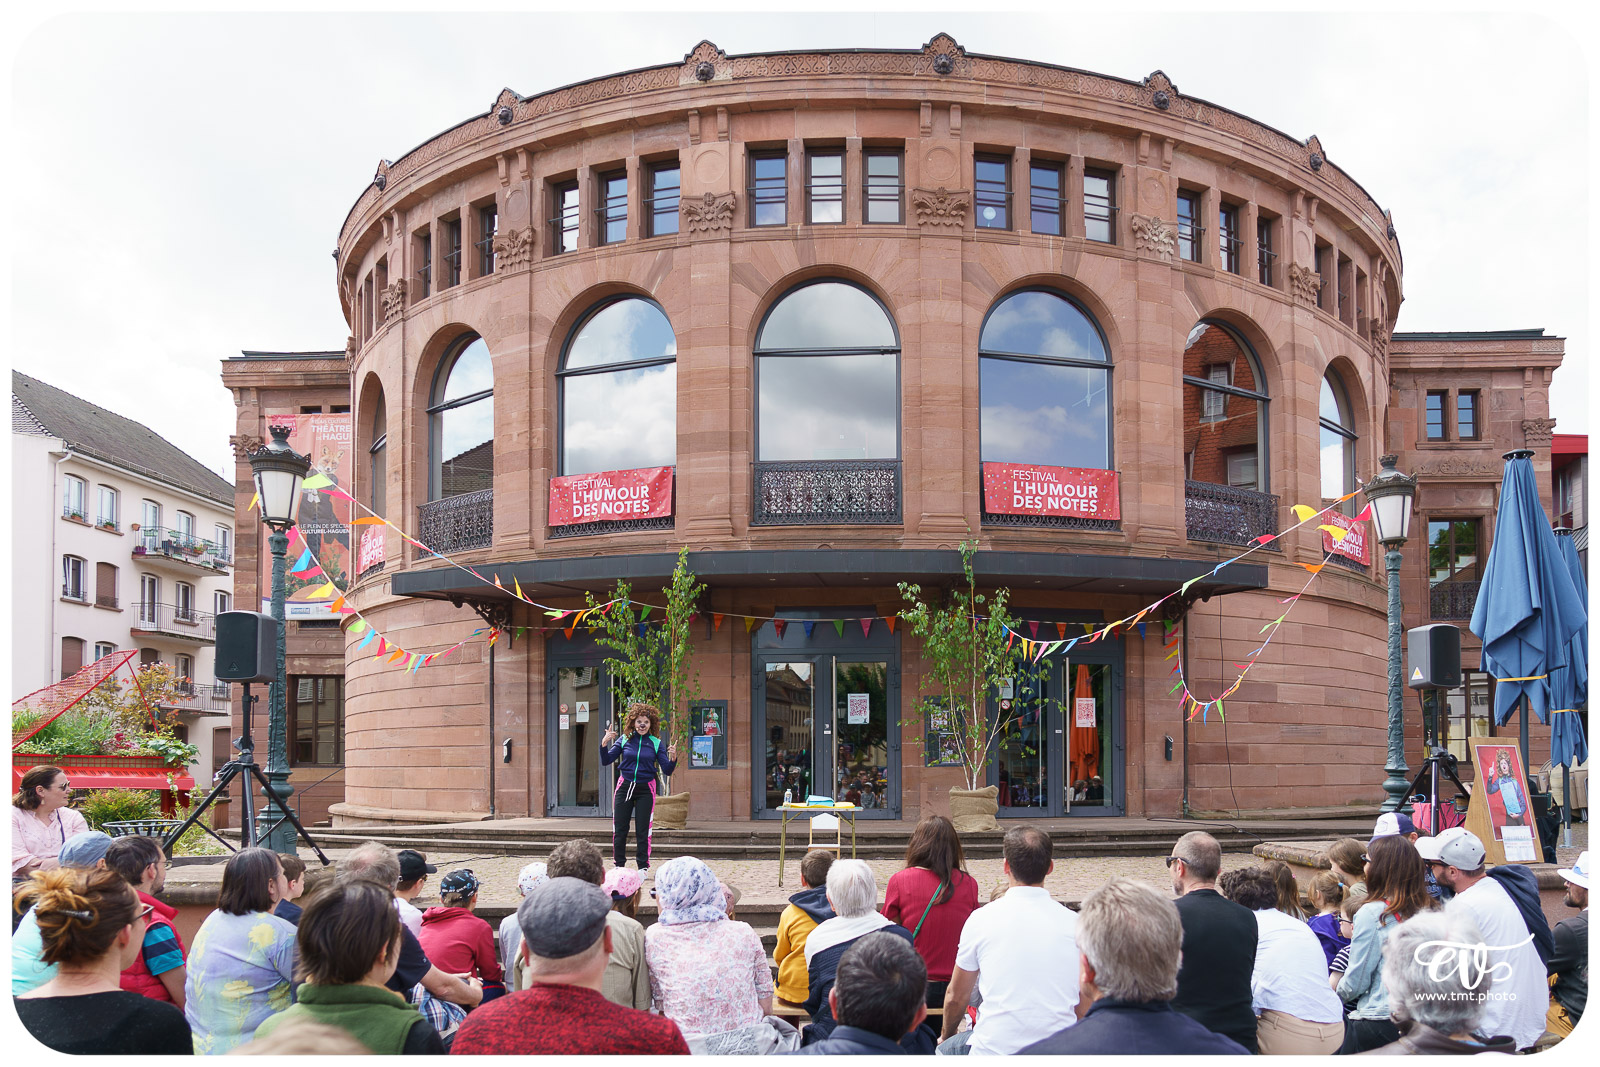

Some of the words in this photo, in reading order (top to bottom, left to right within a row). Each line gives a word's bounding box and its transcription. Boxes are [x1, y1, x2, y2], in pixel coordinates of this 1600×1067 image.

[312, 424, 350, 432] THÉÂTRE
[572, 478, 613, 490] FESTIVAL
[1013, 470, 1058, 482] FESTIVAL
[573, 486, 649, 504] L'HUMOUR
[1013, 481, 1098, 498] L'HUMOUR
[573, 503, 598, 518] DES
[601, 500, 650, 514] NOTES
[1013, 495, 1042, 508] DES
[1048, 497, 1098, 512] NOTES
